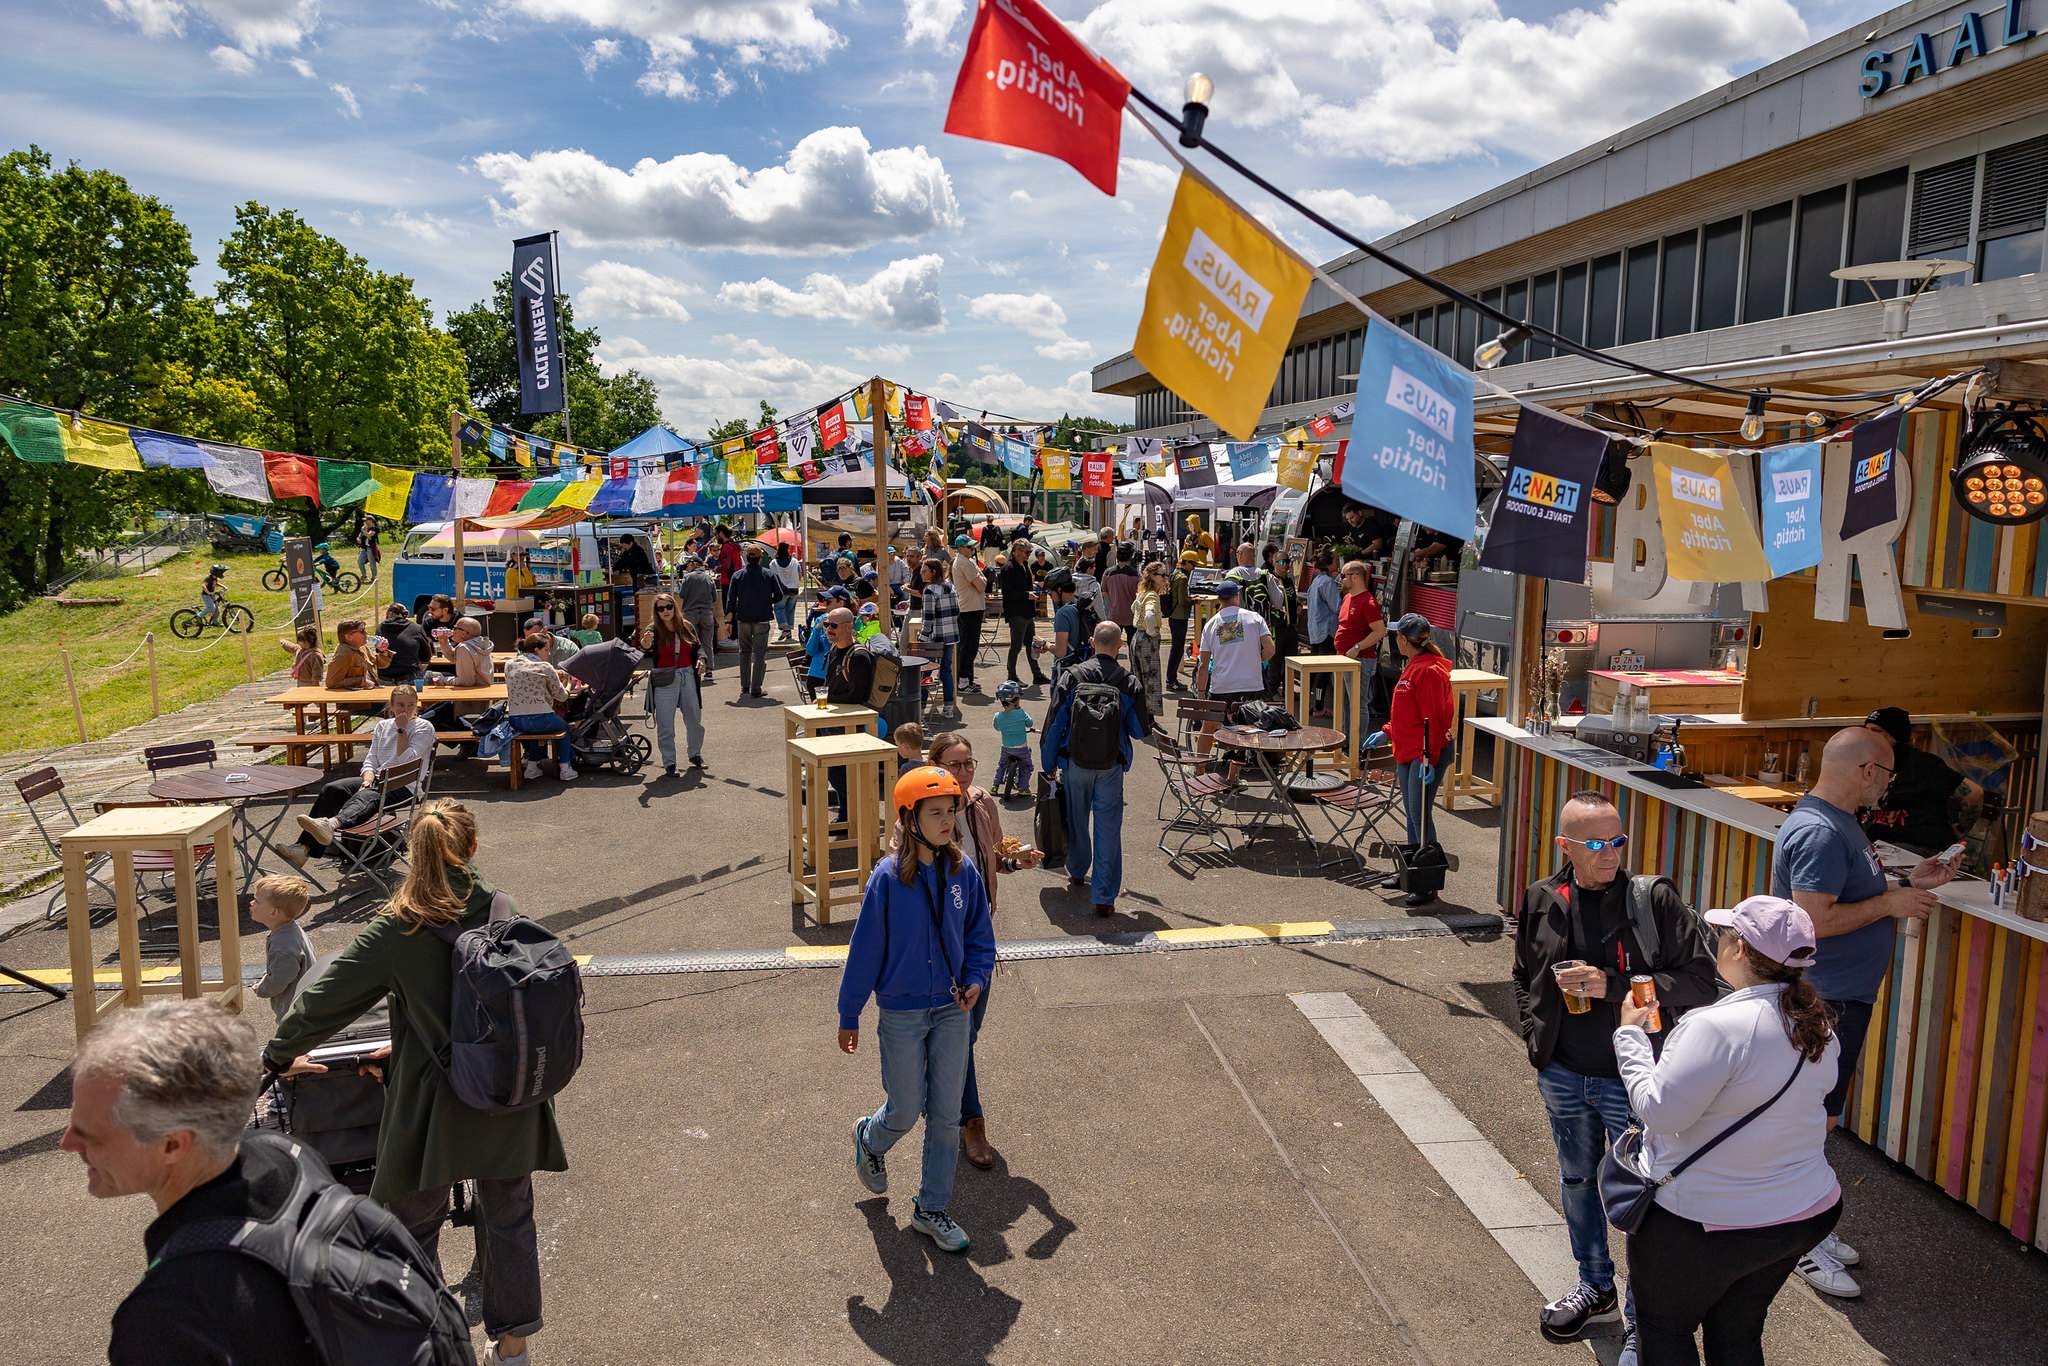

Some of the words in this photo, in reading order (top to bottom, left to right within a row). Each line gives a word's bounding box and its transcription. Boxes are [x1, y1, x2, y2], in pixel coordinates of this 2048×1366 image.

[1858, 0, 2037, 98] SAAL
[717, 494, 765, 509] COFFEE
[532, 1046, 547, 1097] patagonia
